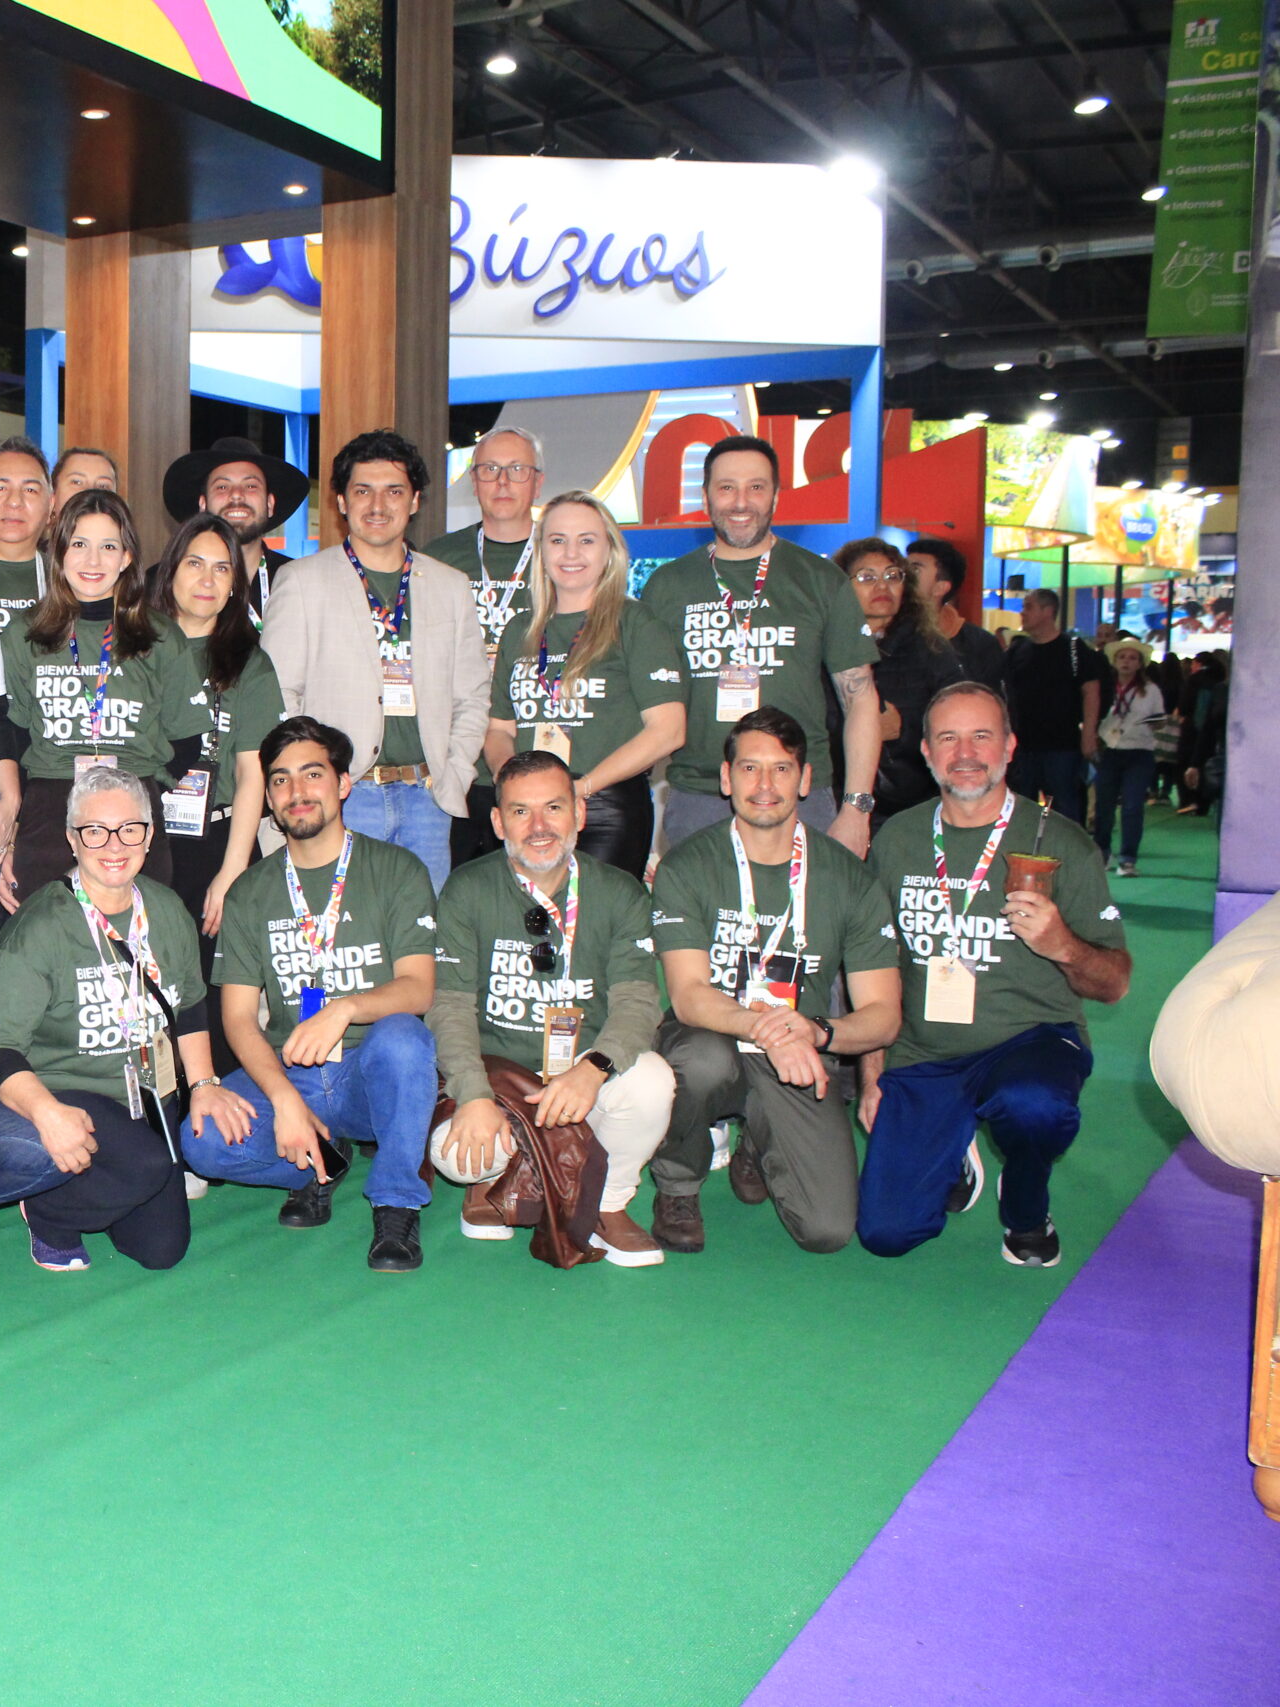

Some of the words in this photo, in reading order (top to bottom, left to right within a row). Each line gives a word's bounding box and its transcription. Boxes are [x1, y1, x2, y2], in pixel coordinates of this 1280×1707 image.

[760, 599, 770, 608] A
[684, 611, 730, 630] RIO
[683, 626, 795, 650] GRANDE
[687, 649, 721, 669] DO
[729, 647, 784, 666] SUL
[113, 666, 123, 676] A
[36, 676, 81, 698] RIO
[980, 881, 990, 892] A
[900, 888, 945, 911] RIO
[342, 911, 352, 923] A
[898, 911, 1016, 940] GRANDE
[941, 938, 1001, 963] SUL
[490, 952, 533, 977] RIO
[323, 968, 374, 993] SUL
[486, 994, 525, 1020] DO
[79, 1026, 123, 1049] DO
